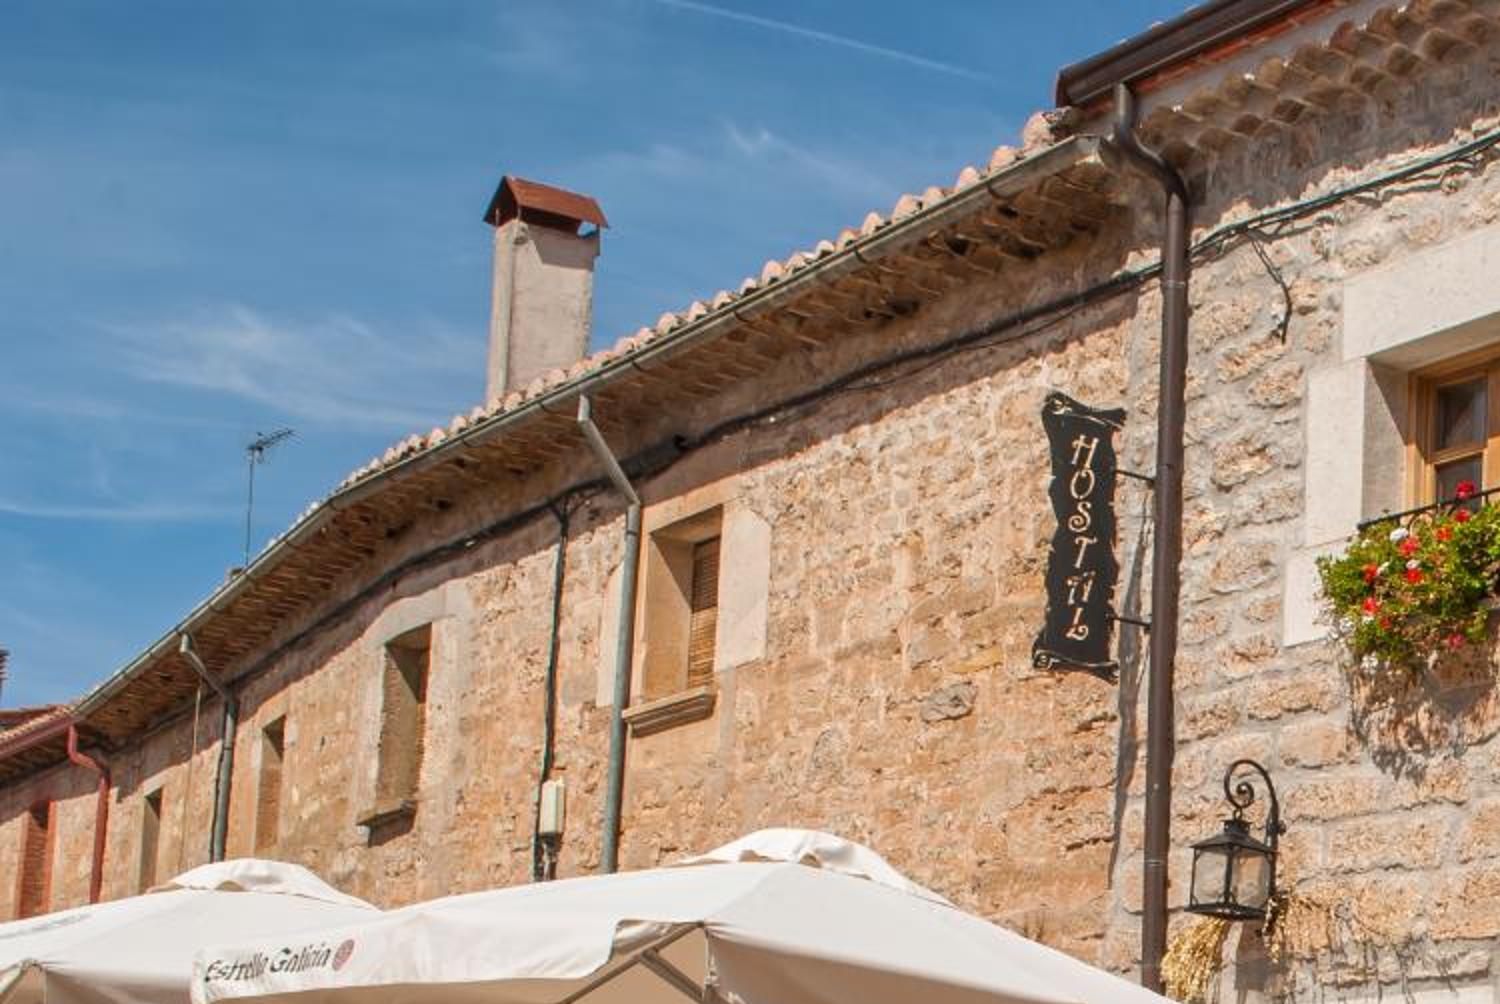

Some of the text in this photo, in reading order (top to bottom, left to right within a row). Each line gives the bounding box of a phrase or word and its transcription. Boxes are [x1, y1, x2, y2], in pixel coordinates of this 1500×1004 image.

[1065, 433, 1098, 641] HOSTAL
[204, 942, 331, 982] Estrella Galicia
